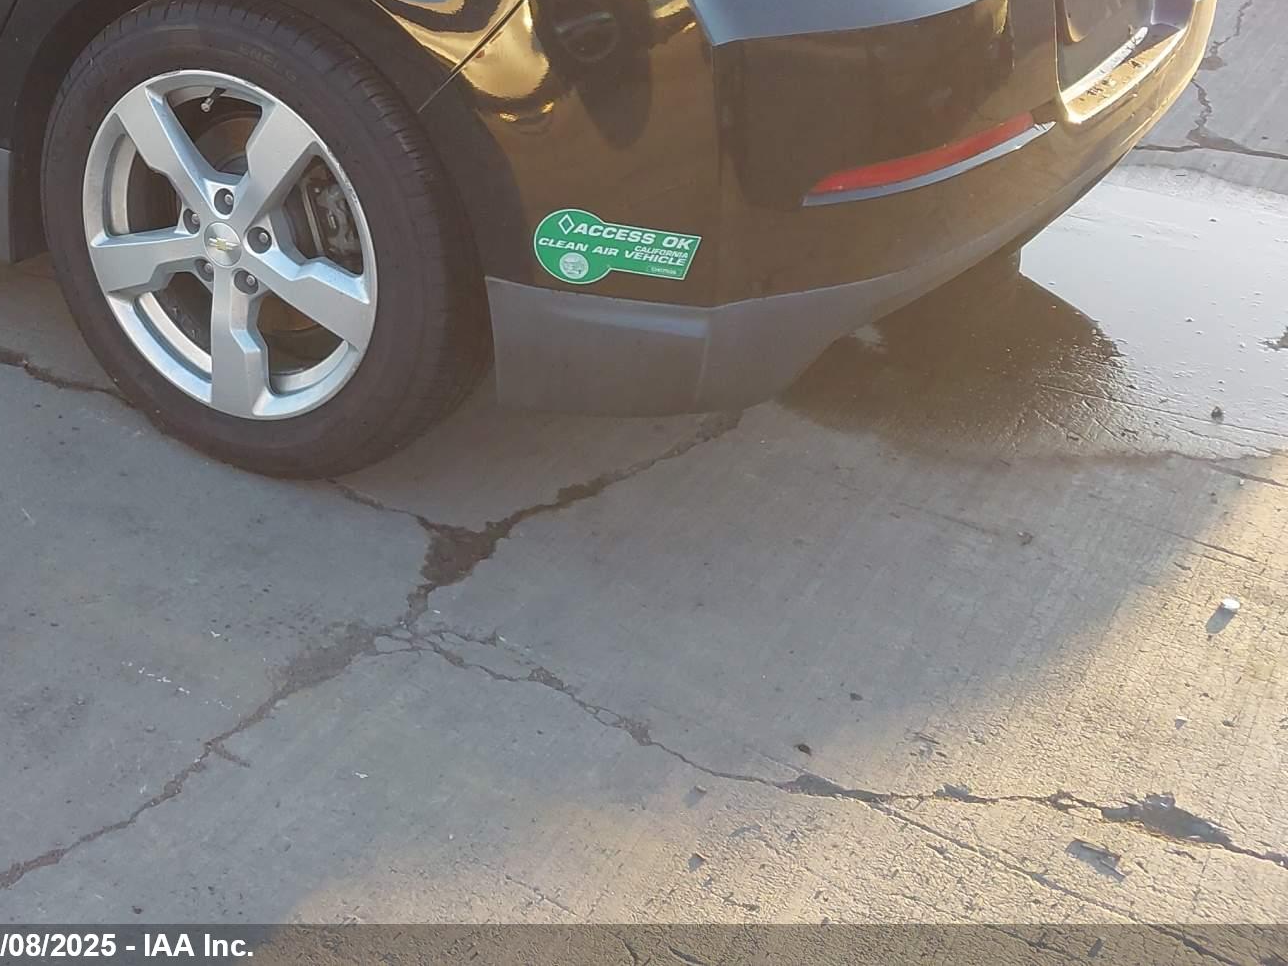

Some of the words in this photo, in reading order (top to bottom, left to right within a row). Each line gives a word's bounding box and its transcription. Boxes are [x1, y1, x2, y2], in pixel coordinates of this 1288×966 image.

[573, 222, 656, 245] ACCESS
[662, 236, 695, 251] OK
[538, 237, 589, 252] CLEAN
[592, 245, 618, 256] AIR
[624, 250, 688, 267] VEHICLE
[634, 245, 690, 259] CALIFORNIA
